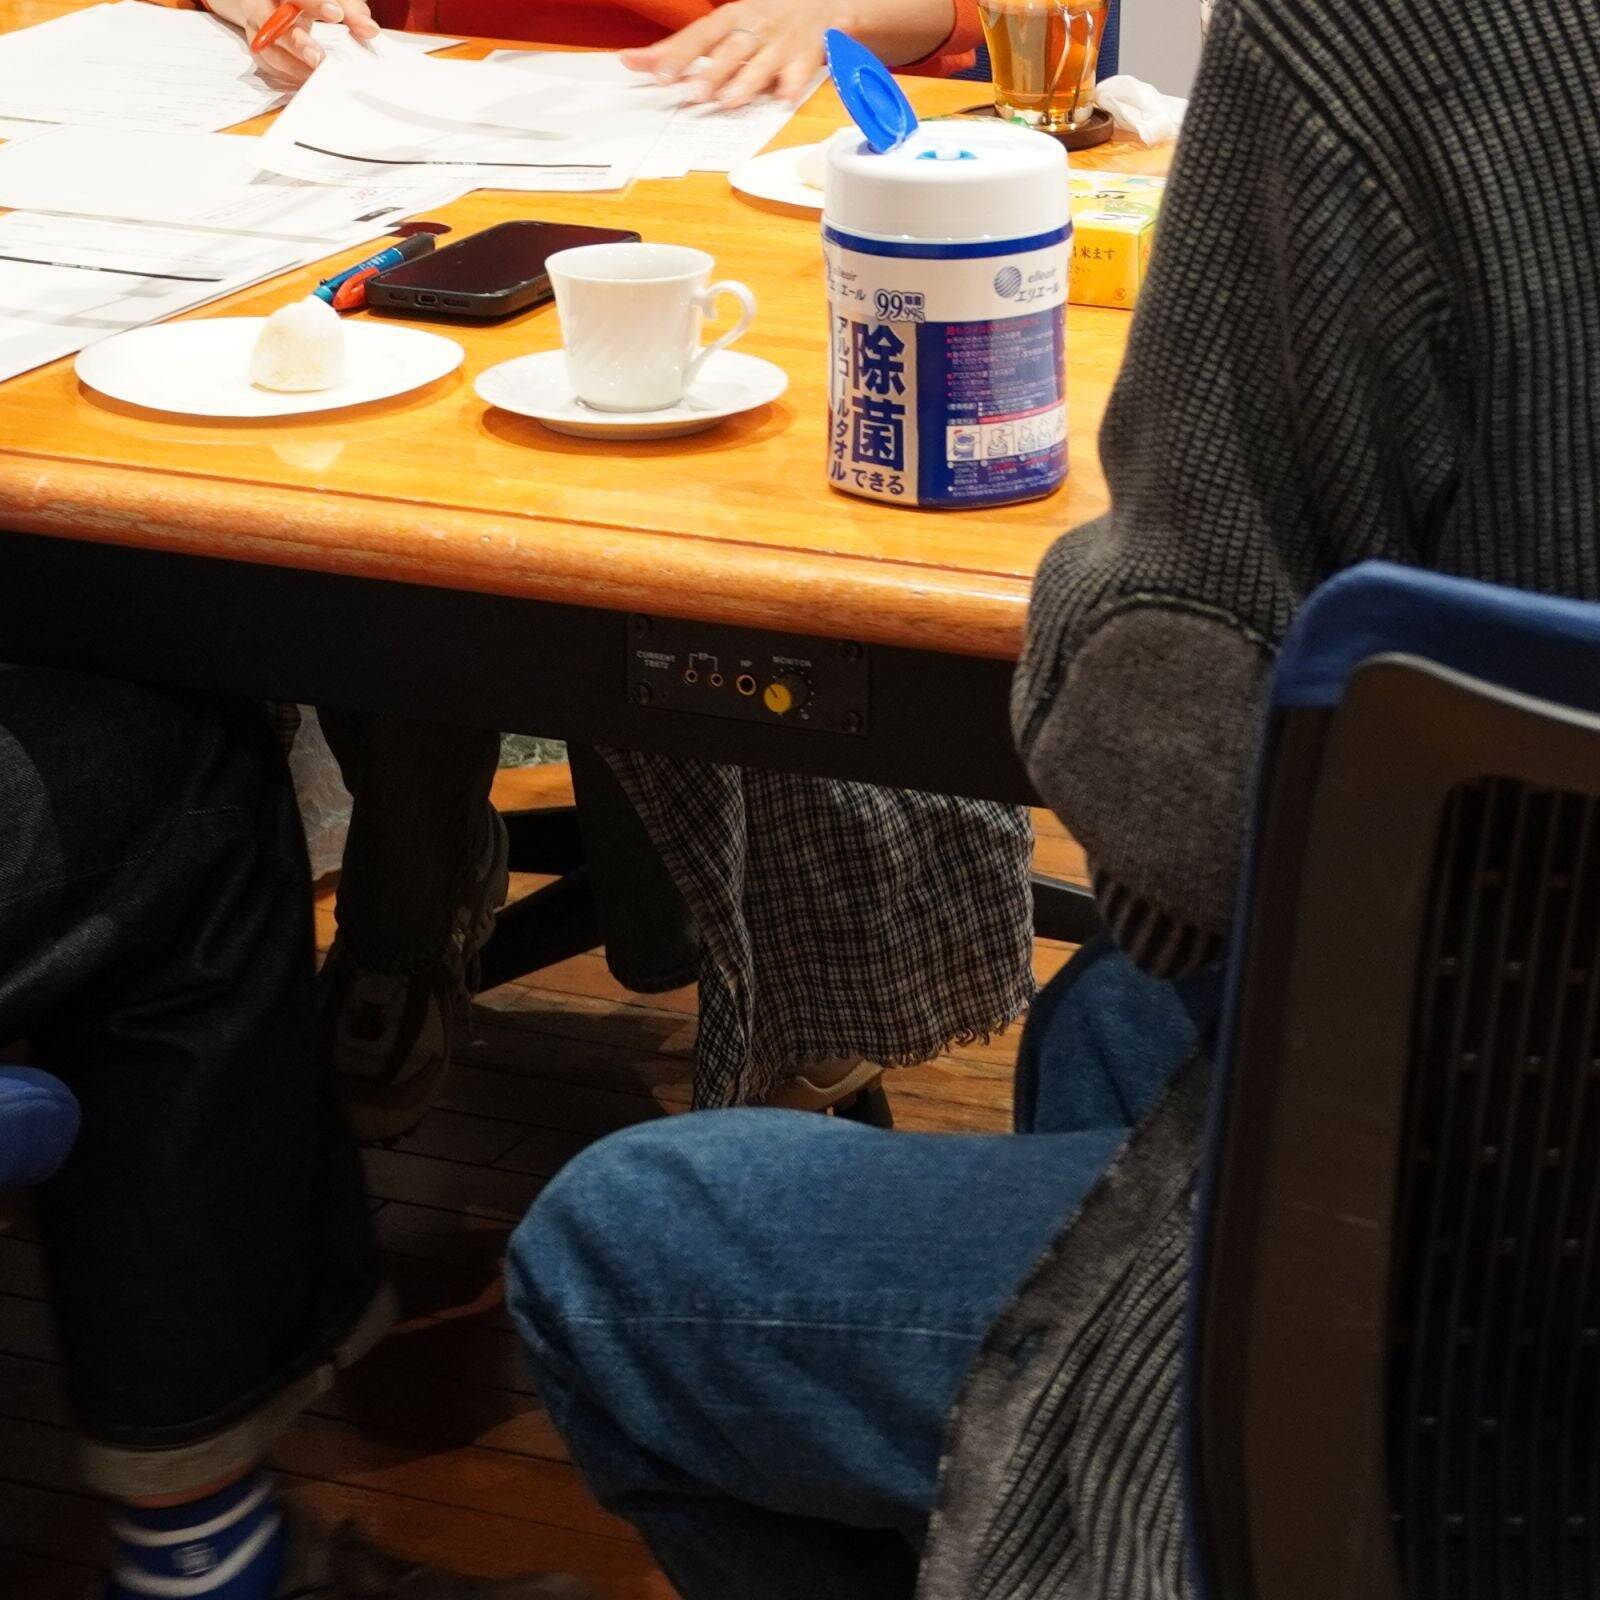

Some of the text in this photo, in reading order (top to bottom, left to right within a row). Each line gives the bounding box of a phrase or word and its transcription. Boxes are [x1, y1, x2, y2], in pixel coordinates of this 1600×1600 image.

[851, 321, 906, 472] 除菌
[851, 467, 905, 496] できる
